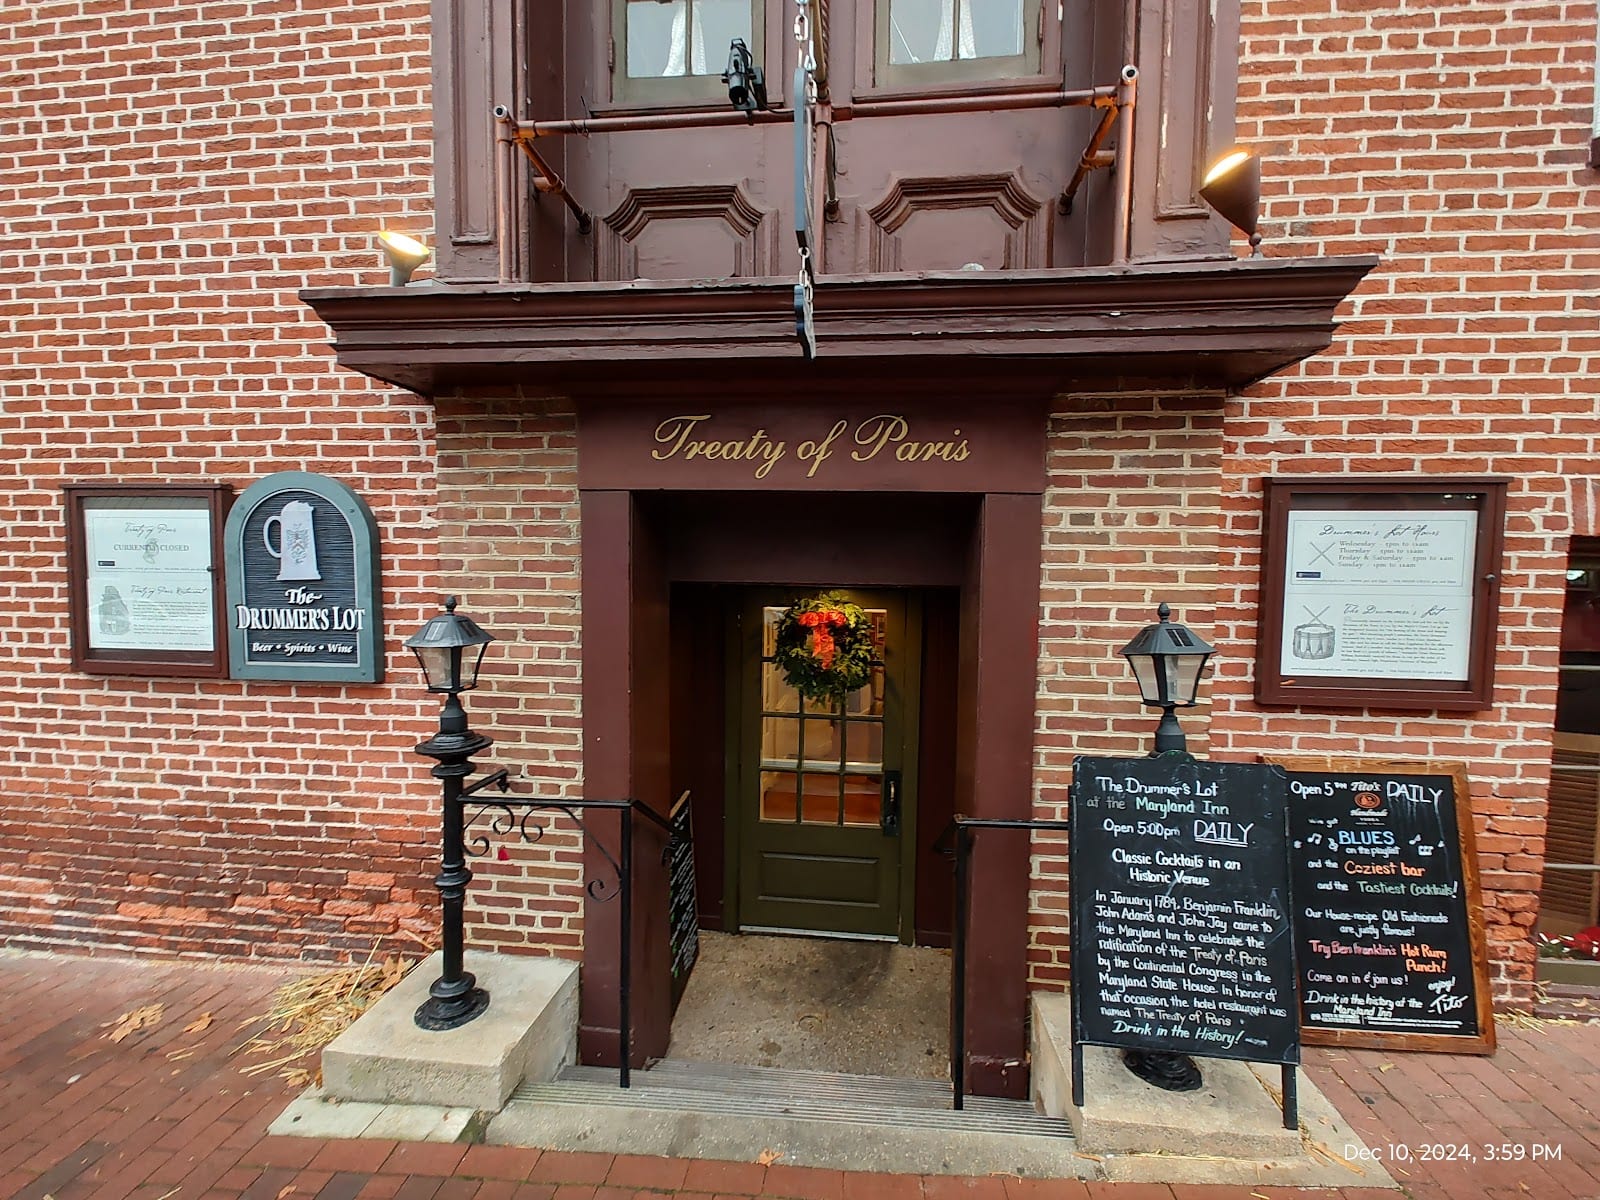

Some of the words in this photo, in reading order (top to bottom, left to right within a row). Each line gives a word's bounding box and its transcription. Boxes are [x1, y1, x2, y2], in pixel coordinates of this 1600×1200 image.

[651, 414, 786, 480] Treaty
[797, 419, 848, 478] of
[851, 414, 971, 462] Paris
[1319, 523, 1380, 536] Drummer's
[160, 544, 190, 552] CLOSED
[284, 586, 323, 605] The
[236, 605, 330, 631] DRUMMER'S
[332, 606, 366, 631] LOT
[252, 642, 273, 652] Beer
[284, 642, 317, 657] Spirits
[327, 643, 353, 654] Wine
[1095, 776, 1124, 792] The
[1125, 777, 1191, 796] Drummer's
[1196, 780, 1219, 797] Lot
[1290, 780, 1322, 800] Open
[1350, 781, 1382, 792] Tito's
[1386, 781, 1443, 808] DAILY
[1086, 796, 1100, 808] at
[1105, 796, 1126, 810] the
[1135, 796, 1195, 819] Maryland
[1202, 800, 1230, 815] Inn
[1103, 818, 1134, 837] Open
[1137, 821, 1180, 840] 5:00pm
[1194, 820, 1255, 843] DAILY
[1338, 830, 1395, 845] BLUES
[1112, 847, 1152, 865] Classic
[1155, 850, 1204, 868] Cocktails
[1208, 857, 1220, 869] in
[1224, 859, 1241, 870] an
[1345, 847, 1357, 855] on
[1357, 845, 1370, 855] the
[1370, 845, 1401, 859] playlist
[1129, 867, 1171, 883] Historic
[1173, 869, 1211, 886] Venue
[1307, 859, 1322, 869] and
[1324, 859, 1339, 869] the
[1344, 860, 1398, 875] Coziest
[1400, 861, 1425, 877] bar
[1317, 880, 1333, 891] and
[1333, 880, 1349, 891] the
[1356, 881, 1407, 895] Tastiest
[1095, 889, 1107, 902] In
[1109, 890, 1152, 914] January
[1183, 897, 1232, 917] Benjamin
[1095, 905, 1120, 919] John
[1121, 907, 1155, 923] Adams
[1157, 912, 1176, 925] and
[1178, 913, 1205, 927] John
[1207, 915, 1228, 933] Jay
[1233, 921, 1260, 932] came
[1261, 921, 1273, 933] to
[1305, 907, 1322, 919] Our
[1382, 909, 1398, 922] Old
[1400, 910, 1449, 924] Fashioneds
[1096, 921, 1115, 935] the
[1118, 924, 1161, 943] Maryland
[1165, 928, 1180, 941] Inn
[1183, 929, 1195, 942] to
[1198, 933, 1244, 947] celebrate
[1245, 936, 1266, 950] the
[1339, 924, 1355, 935] are
[1355, 924, 1379, 939] justly
[1098, 938, 1152, 954] ratification
[1155, 942, 1168, 957] of
[1169, 945, 1188, 959] the
[1189, 946, 1222, 965] Treaty
[1225, 948, 1236, 965] of
[1239, 951, 1268, 967] Paris
[1308, 939, 1331, 959] Try
[1331, 940, 1353, 954] Ben
[1353, 942, 1397, 956] Franklin's
[1400, 943, 1420, 957] Hot
[1420, 943, 1447, 959] Rum
[1097, 953, 1111, 972] by
[1113, 955, 1130, 969] the
[1133, 957, 1186, 974] Continental
[1188, 963, 1238, 982] Congress
[1242, 968, 1253, 982] in
[1254, 969, 1272, 984] the
[1405, 958, 1447, 973] Punch!
[1098, 972, 1148, 993] Maryland
[1151, 975, 1179, 991] State
[1222, 983, 1233, 997] In
[1235, 984, 1265, 999] honor
[1265, 988, 1278, 1003] of
[1307, 969, 1333, 983] Come
[1336, 974, 1348, 984] on
[1351, 972, 1361, 984] in
[1364, 971, 1371, 983] &
[1370, 972, 1389, 988] join
[1099, 988, 1122, 1003] that
[1170, 994, 1189, 1008] the
[1193, 997, 1217, 1010] hotel
[1218, 1000, 1268, 1016] restaurant
[1269, 1007, 1287, 1018] was
[1304, 989, 1339, 1004] Drink
[1339, 993, 1349, 1005] in
[1350, 993, 1365, 1006] the
[1366, 993, 1394, 1011] history
[1395, 997, 1406, 1008] at
[1406, 998, 1424, 1009] the
[1100, 1006, 1131, 1018] named
[1133, 1006, 1156, 1020] The
[1155, 1009, 1186, 1026] Treaty
[1188, 1010, 1202, 1024] of
[1205, 1011, 1232, 1027] Paris
[1333, 1004, 1375, 1017] Maryland
[1377, 1007, 1393, 1018] Inn
[1112, 1020, 1152, 1036] Drink
[1156, 1025, 1168, 1037] in
[1171, 1024, 1190, 1039] the
[1195, 1026, 1245, 1050] History!
